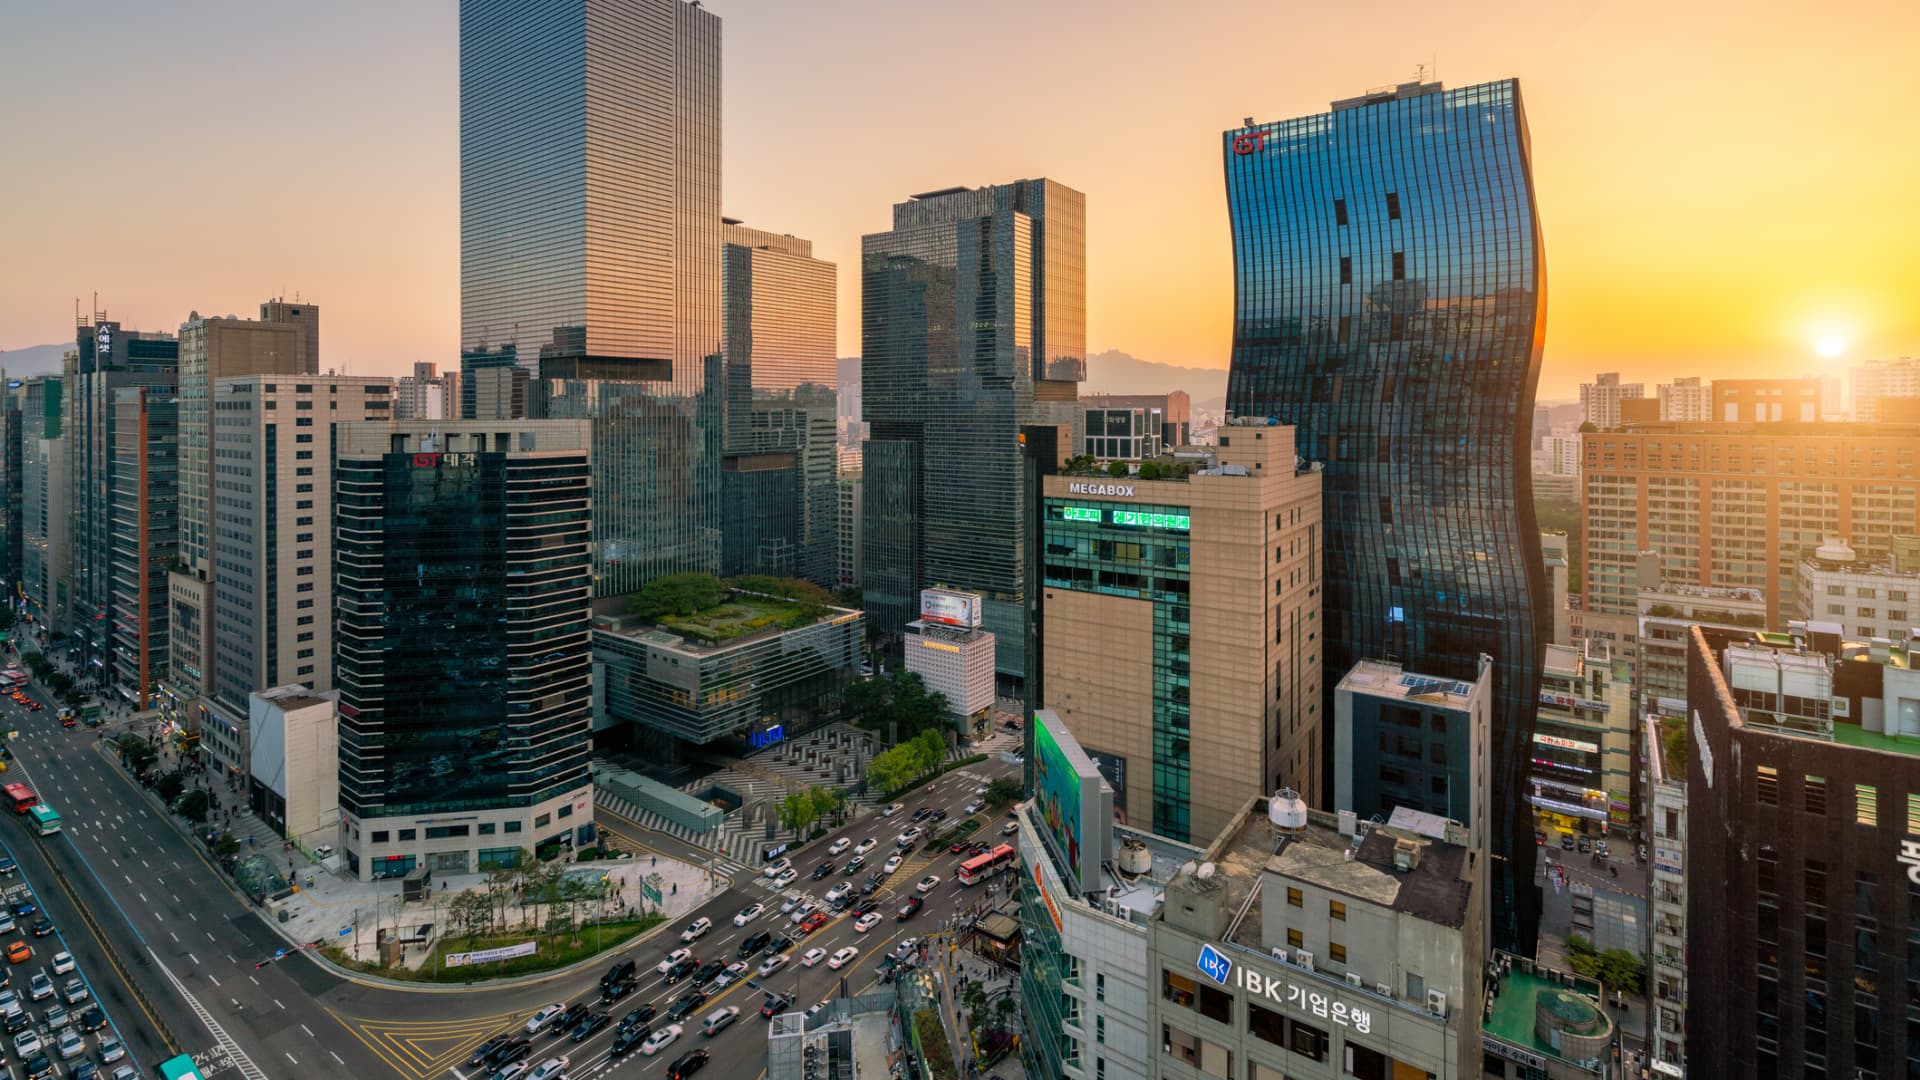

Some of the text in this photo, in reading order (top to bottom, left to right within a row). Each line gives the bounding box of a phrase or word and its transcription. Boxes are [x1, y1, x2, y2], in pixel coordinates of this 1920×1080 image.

[1233, 130, 1271, 155] GT
[413, 453, 441, 467] GT
[1069, 483, 1134, 497] MEGABOX
[1237, 966, 1371, 1034] IBK 기업은행
